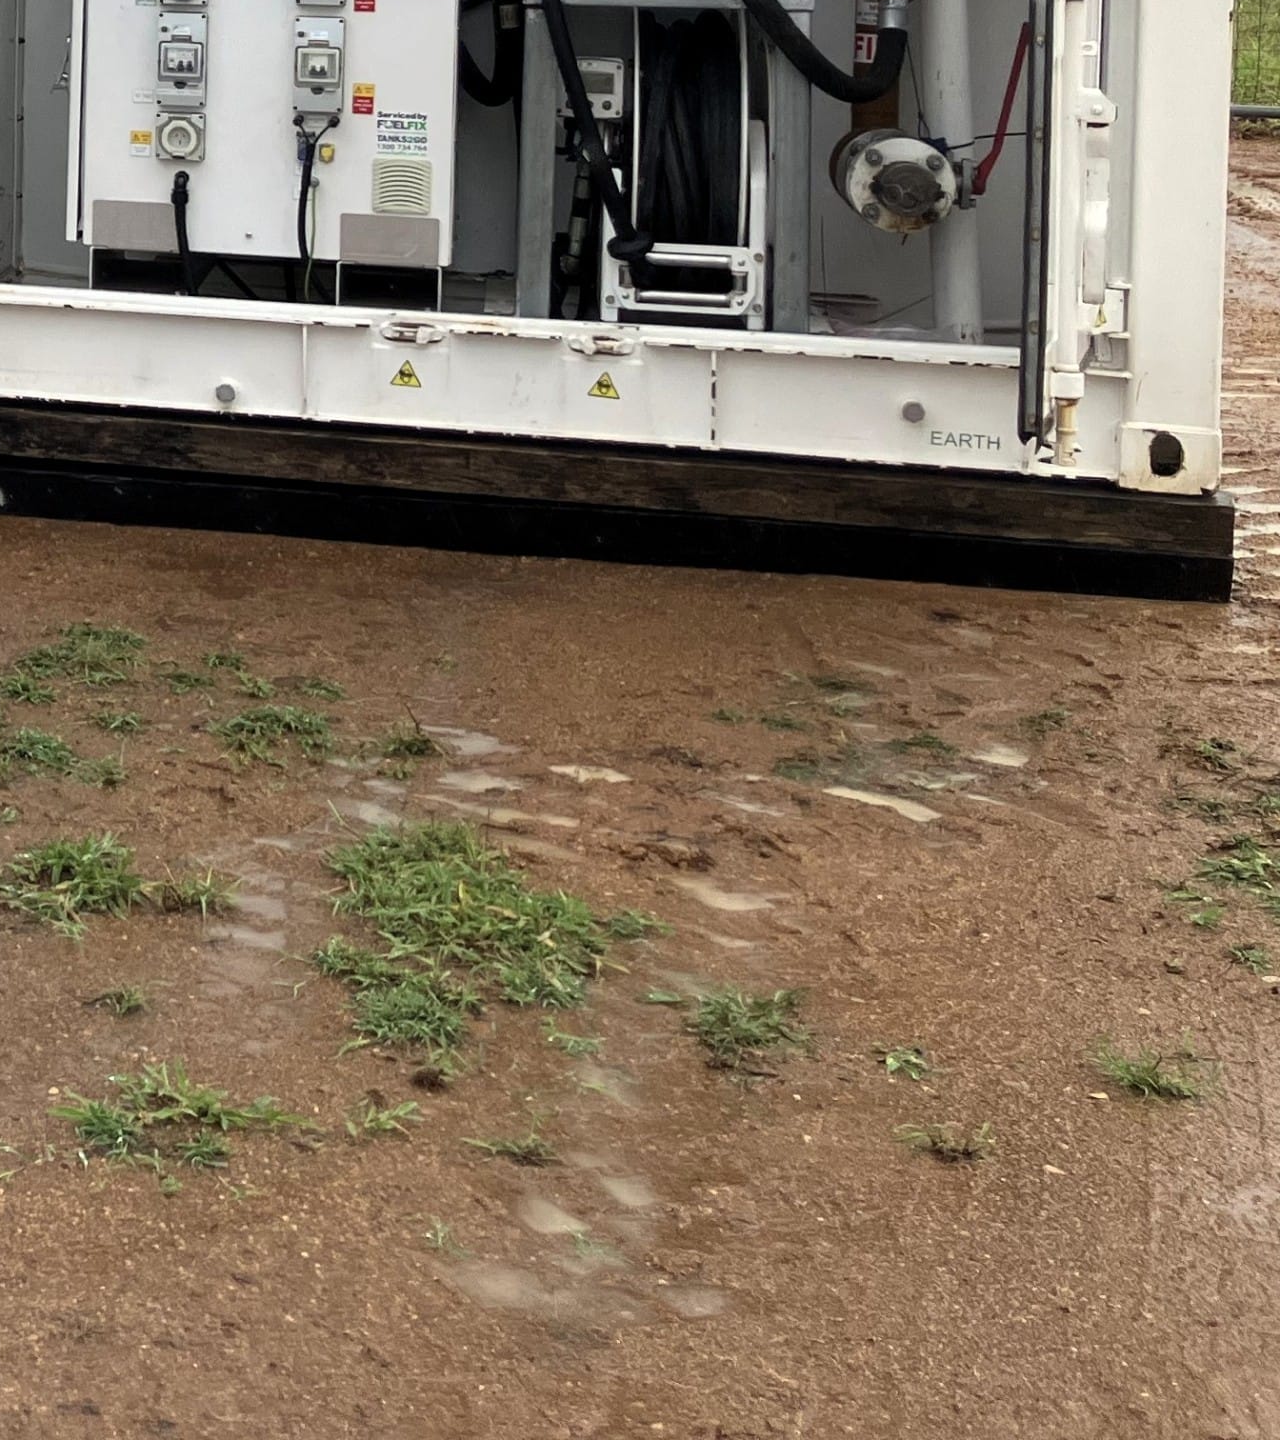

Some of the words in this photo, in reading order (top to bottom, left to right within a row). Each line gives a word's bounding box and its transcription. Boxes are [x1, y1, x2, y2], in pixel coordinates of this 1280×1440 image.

[377, 111, 416, 119] Serviced
[417, 112, 427, 121] by
[929, 430, 1001, 451] EARTH
